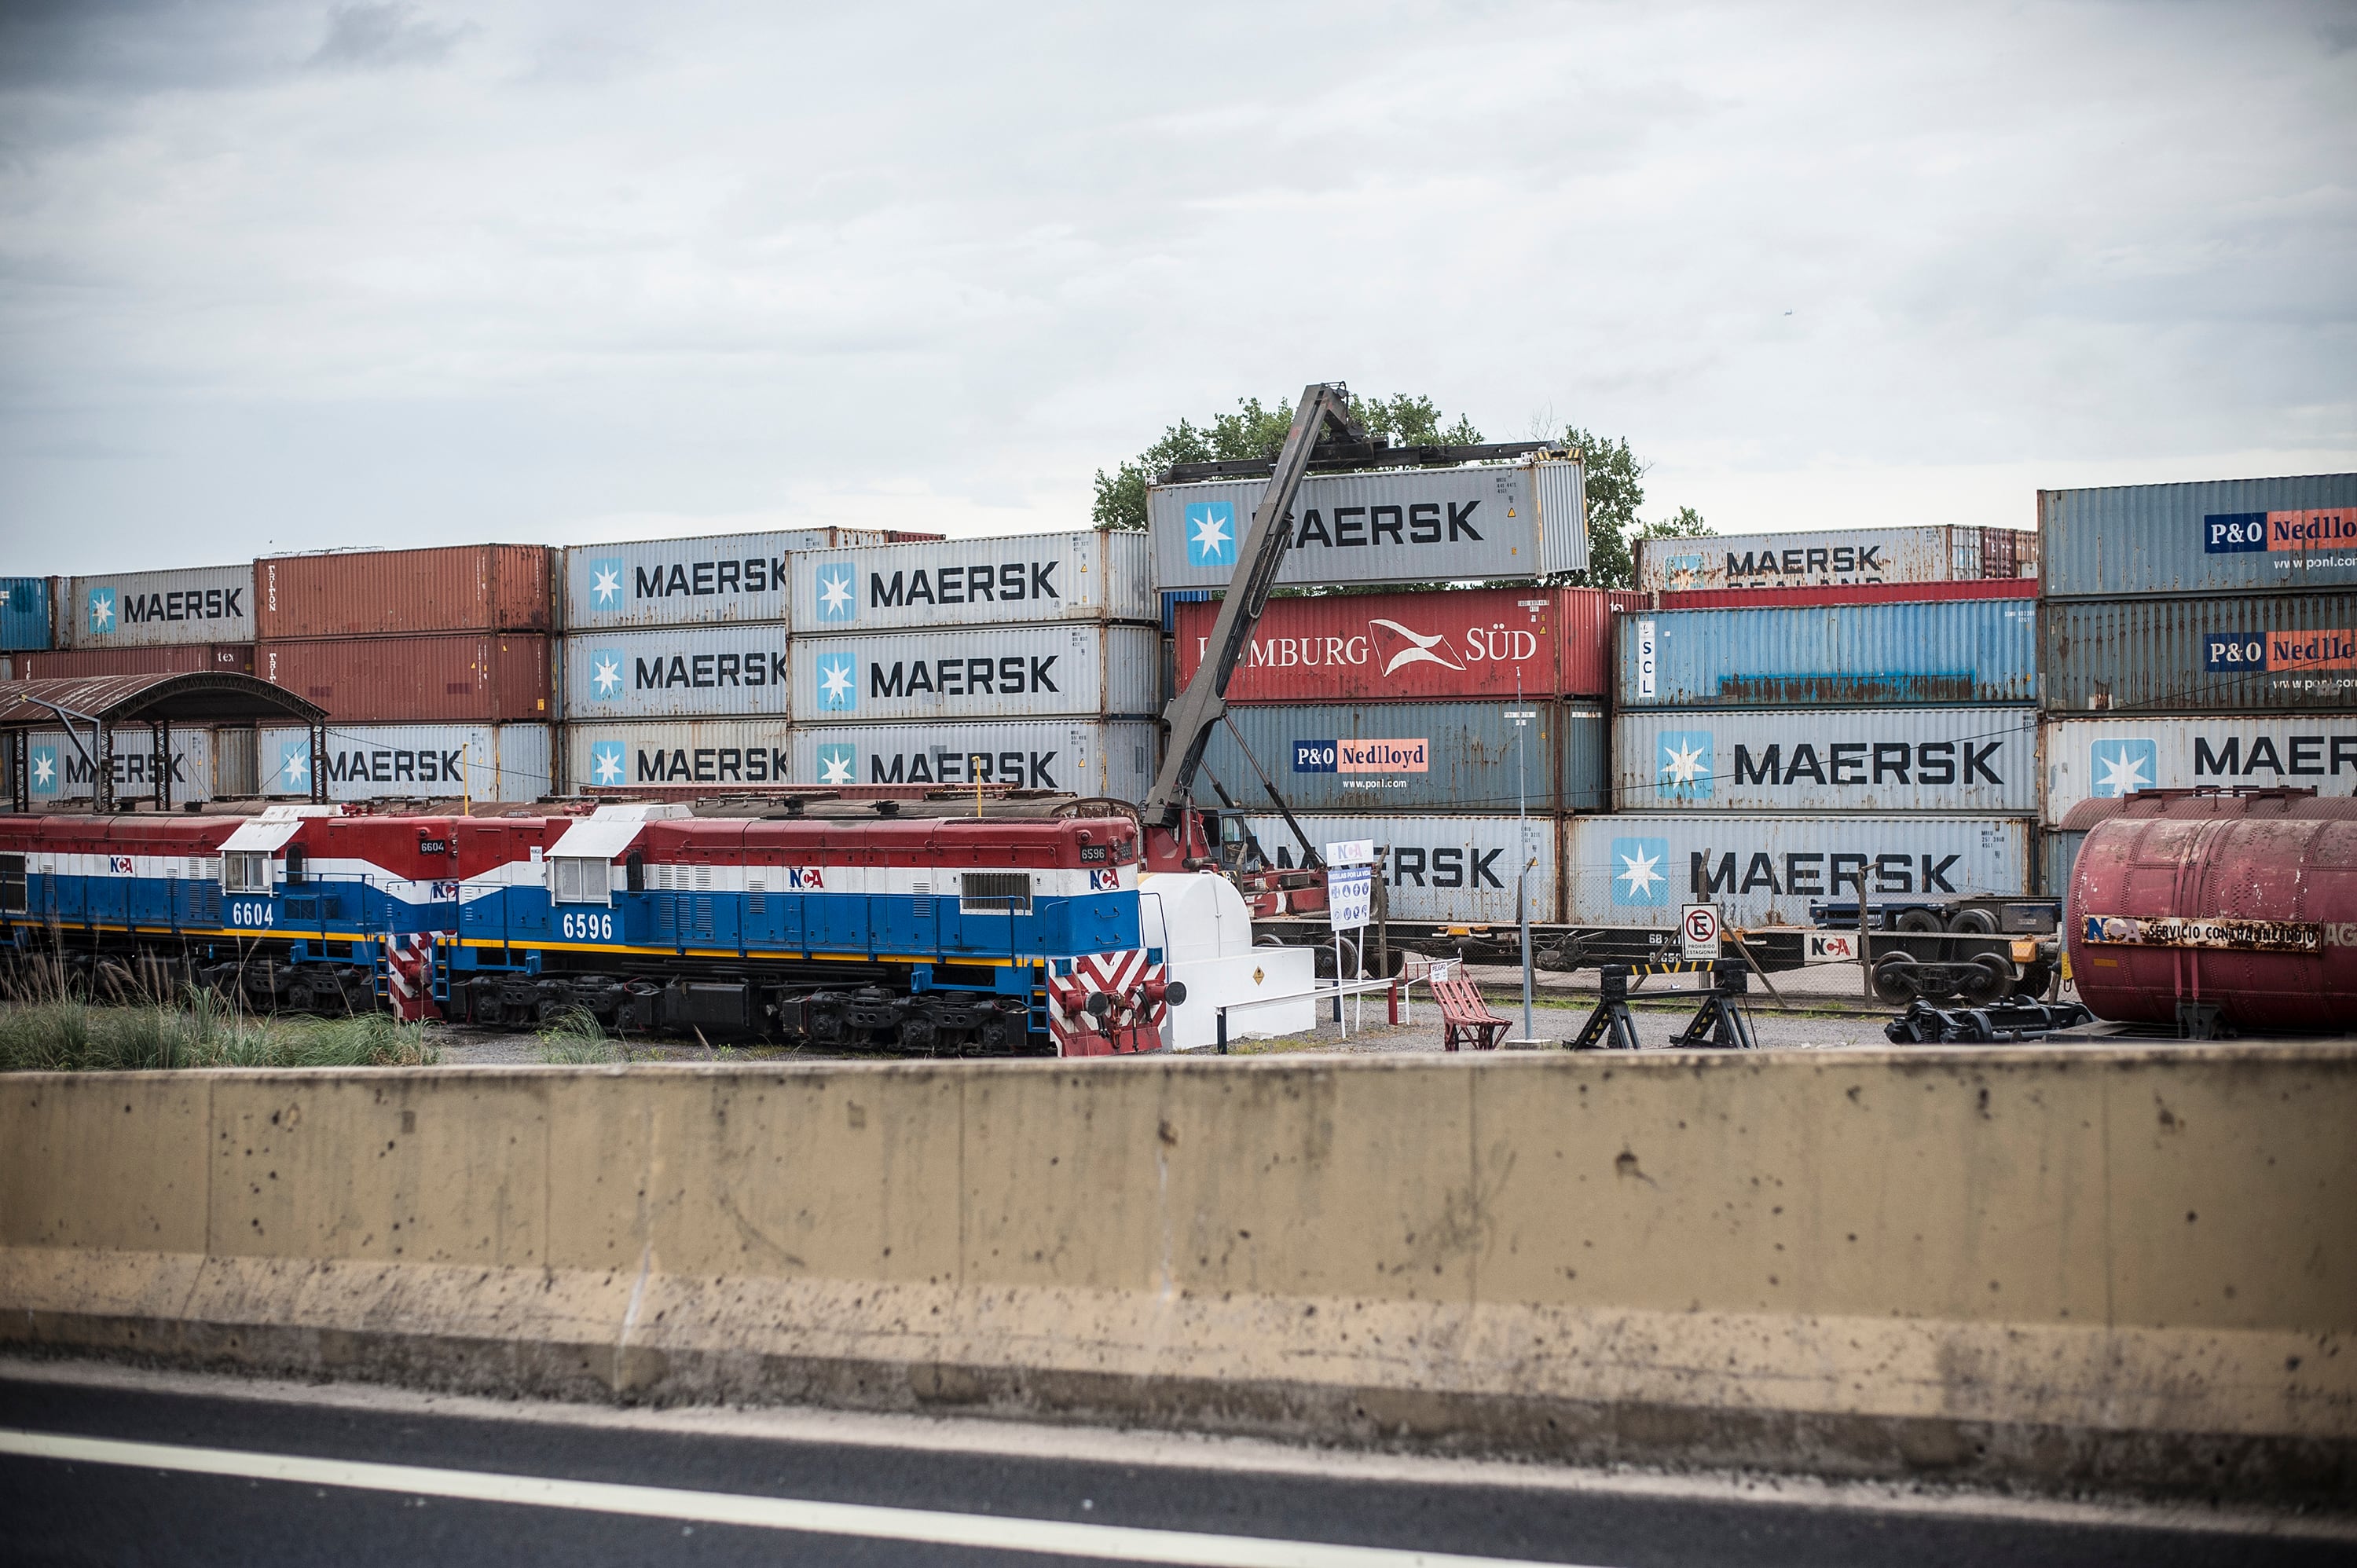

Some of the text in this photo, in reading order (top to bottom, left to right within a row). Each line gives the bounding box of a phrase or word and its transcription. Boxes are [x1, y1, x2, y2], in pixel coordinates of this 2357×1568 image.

[1252, 500, 1484, 550] AERSK
[2211, 522, 2263, 544] P&O
[1727, 545, 1881, 577] MAERSK
[871, 561, 1060, 608] MAERSK
[124, 588, 244, 623] MAERSK
[218, 652, 234, 662] tex
[1197, 623, 1537, 669] MBURG SÜD
[2210, 642, 2262, 663] P&O
[871, 654, 1060, 698] MAERSK
[66, 753, 185, 784] MERSK
[325, 749, 464, 782] MAERSK
[871, 750, 1060, 787] MAERSK
[1298, 745, 1424, 769] P&O Nedlloyd
[1734, 741, 2005, 786] MAERSK
[1343, 779, 1407, 790] www.ponl.com
[421, 841, 444, 852] 6604
[1082, 848, 1105, 859] 6596
[1338, 843, 1362, 859] NCA
[111, 857, 133, 874] NCA
[1691, 852, 1962, 896] MAERSK
[790, 868, 824, 888] NCA
[1090, 868, 1120, 889] NCA
[233, 902, 273, 926] 6604
[563, 913, 611, 940] 6596
[2088, 917, 2143, 943] NCA
[2149, 925, 2315, 943] SERVICIO CONTRA INCENDIO
[1812, 938, 1851, 957] NCA
